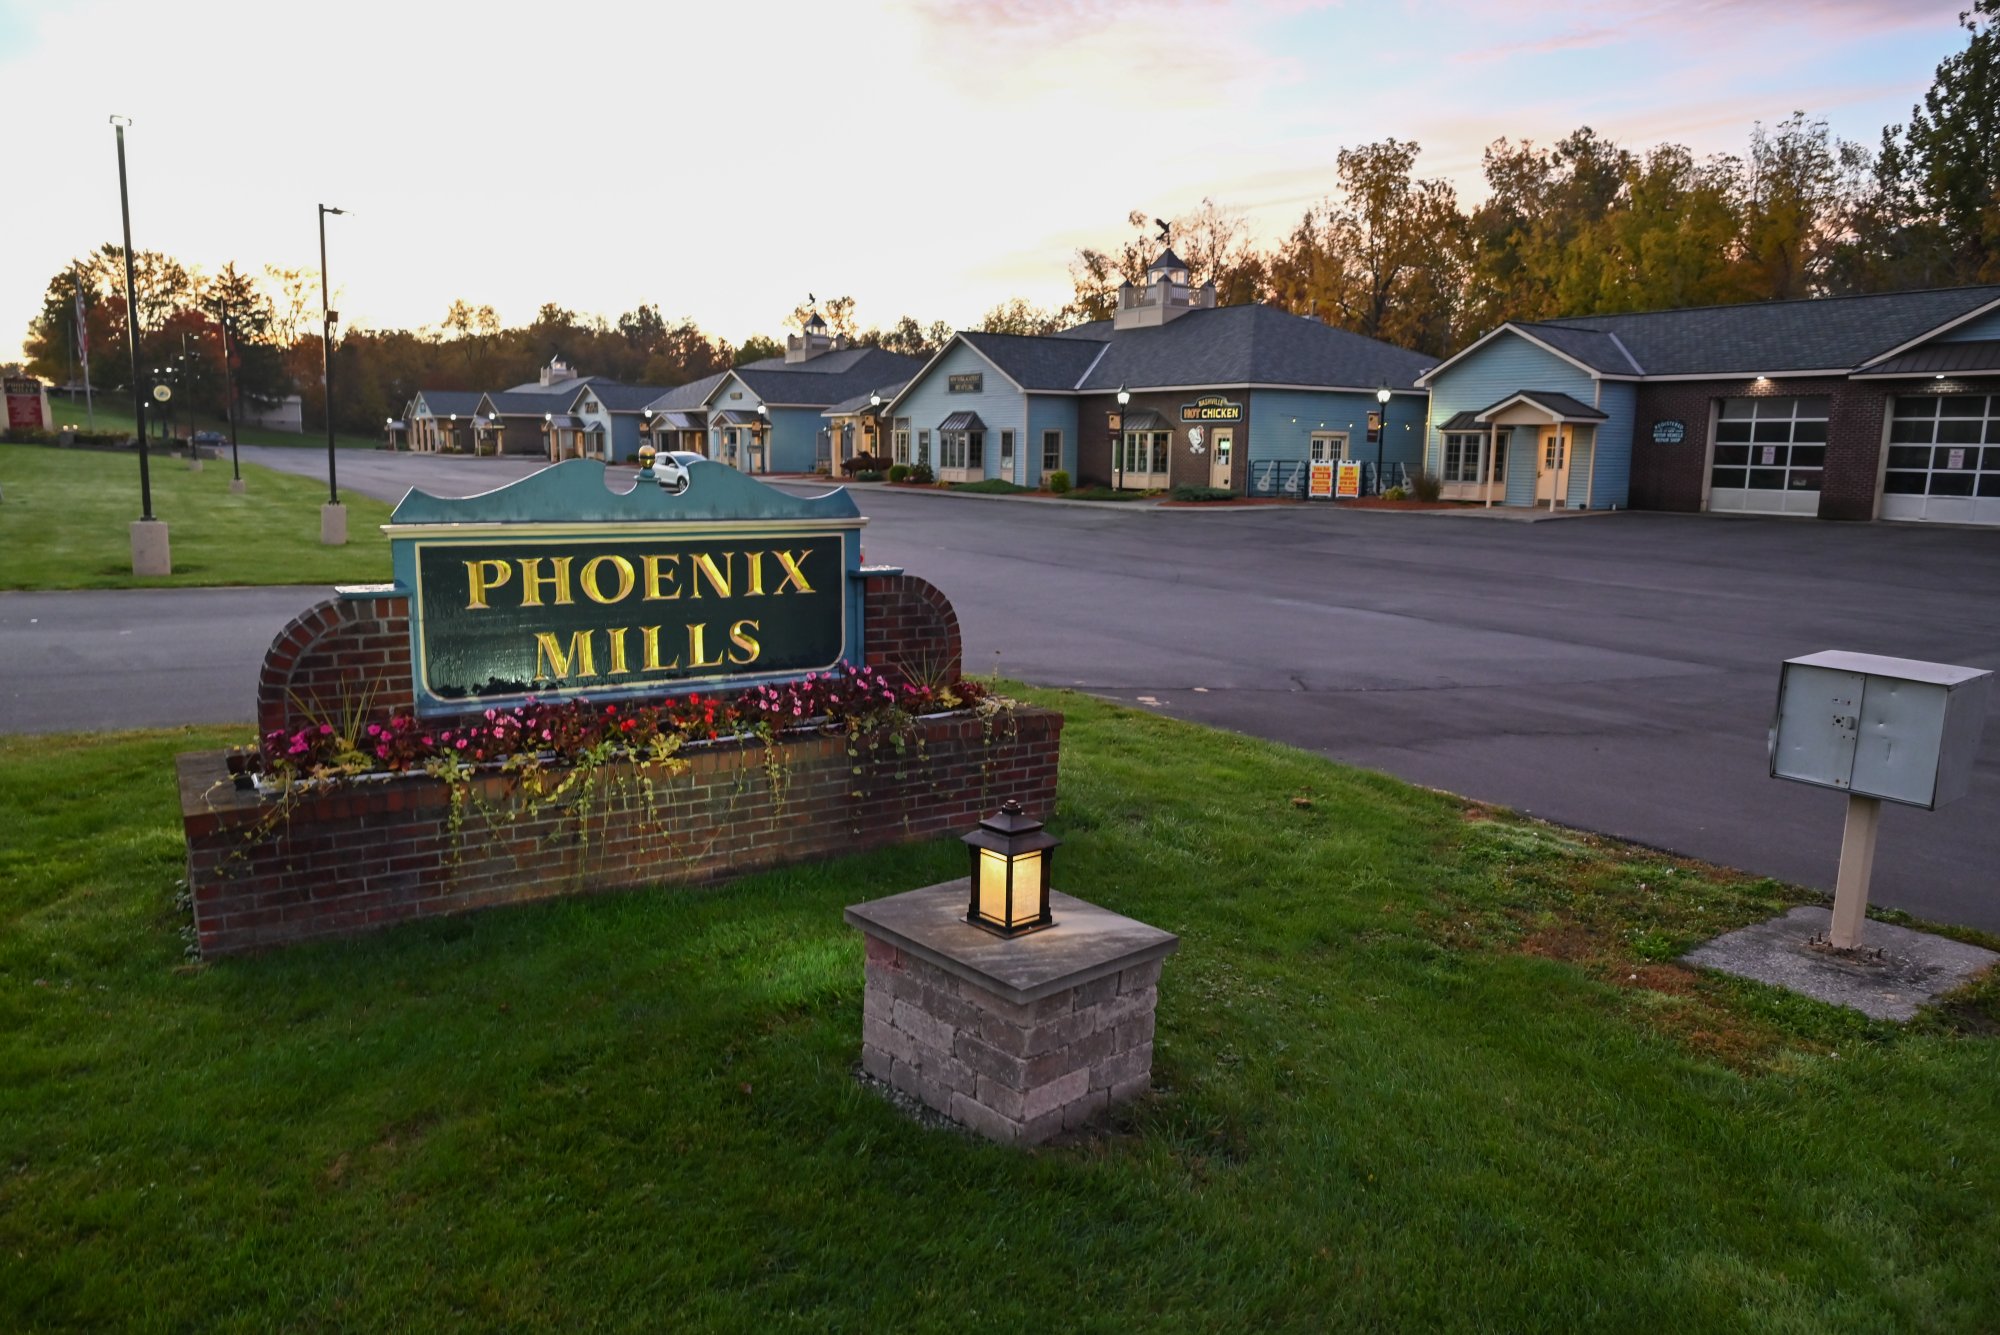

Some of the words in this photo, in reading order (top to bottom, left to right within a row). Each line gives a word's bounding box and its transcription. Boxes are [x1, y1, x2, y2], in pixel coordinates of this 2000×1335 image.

[1198, 398, 1223, 407] NASHVILLE
[1184, 408, 1200, 418] HOT
[1202, 408, 1238, 418] CHICKEN
[1654, 421, 1684, 429] REGISTERED
[463, 549, 817, 611] PHOENIX
[535, 620, 762, 681] MILLS
